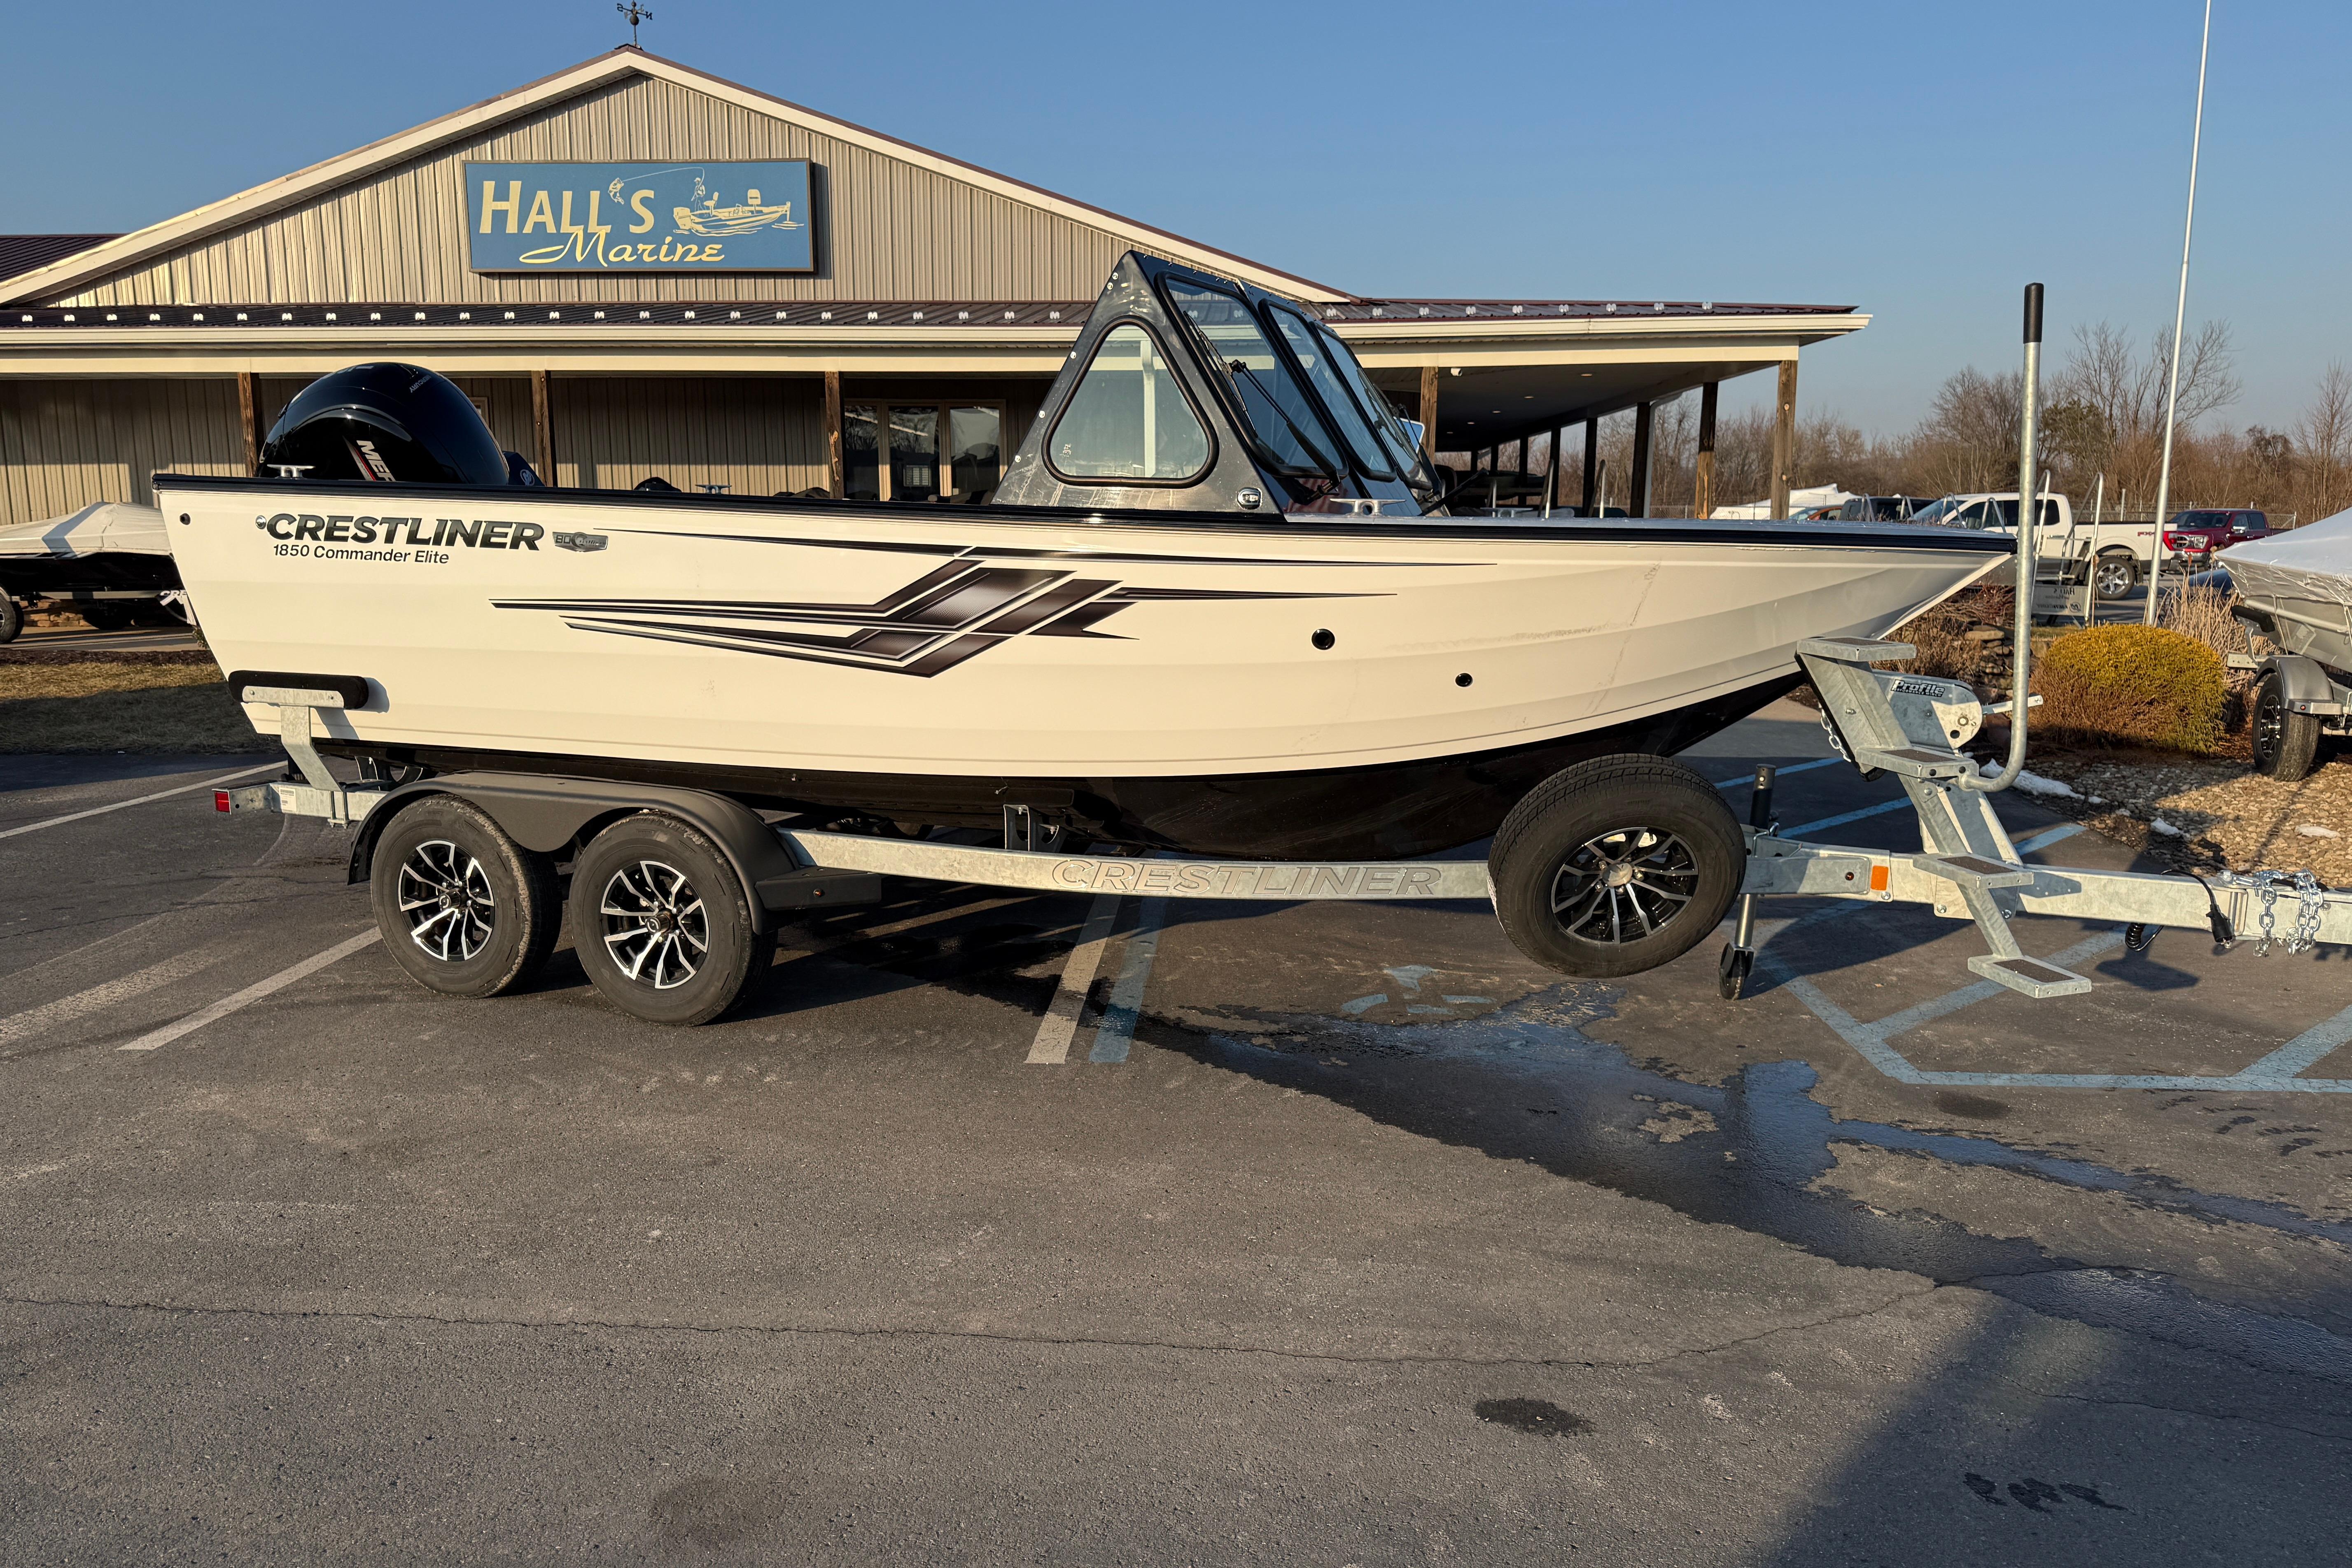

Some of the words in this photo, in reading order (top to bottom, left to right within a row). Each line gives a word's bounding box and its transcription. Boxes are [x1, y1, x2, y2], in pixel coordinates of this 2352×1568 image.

[479, 180, 655, 233] HALL'S
[519, 229, 725, 267] Marine
[266, 513, 545, 551] CRESTLINER
[273, 544, 310, 557] 1850
[314, 546, 410, 562] Commander
[414, 550, 449, 564] Elite
[1891, 679, 1945, 695] Profile
[1051, 859, 1442, 896] CRESTLINER
